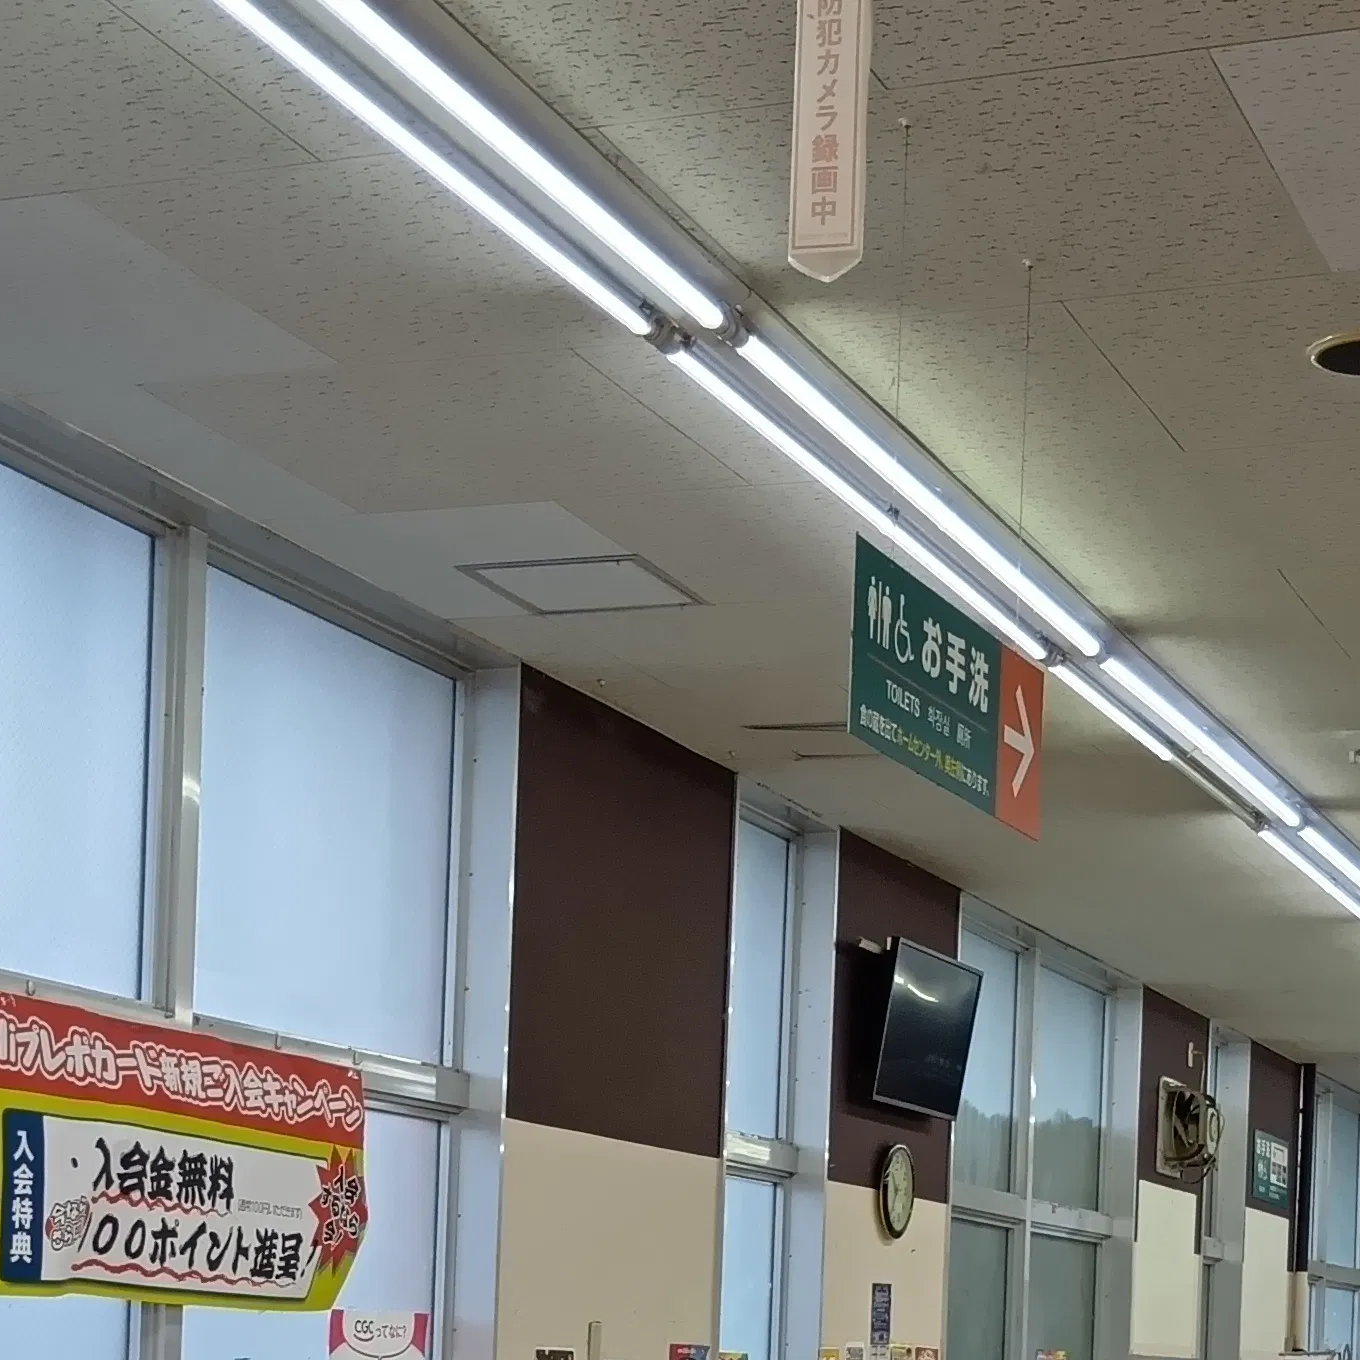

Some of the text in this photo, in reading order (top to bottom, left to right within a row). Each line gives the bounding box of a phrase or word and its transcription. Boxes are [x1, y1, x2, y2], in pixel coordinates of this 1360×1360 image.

[811, 0, 842, 226] 防犯カメラ録画中
[886, 680, 920, 717] TOILETS
[922, 617, 989, 713] お手洗
[10, 1131, 34, 1263] 入会特典
[92, 1137, 235, 1212] 入会金無料
